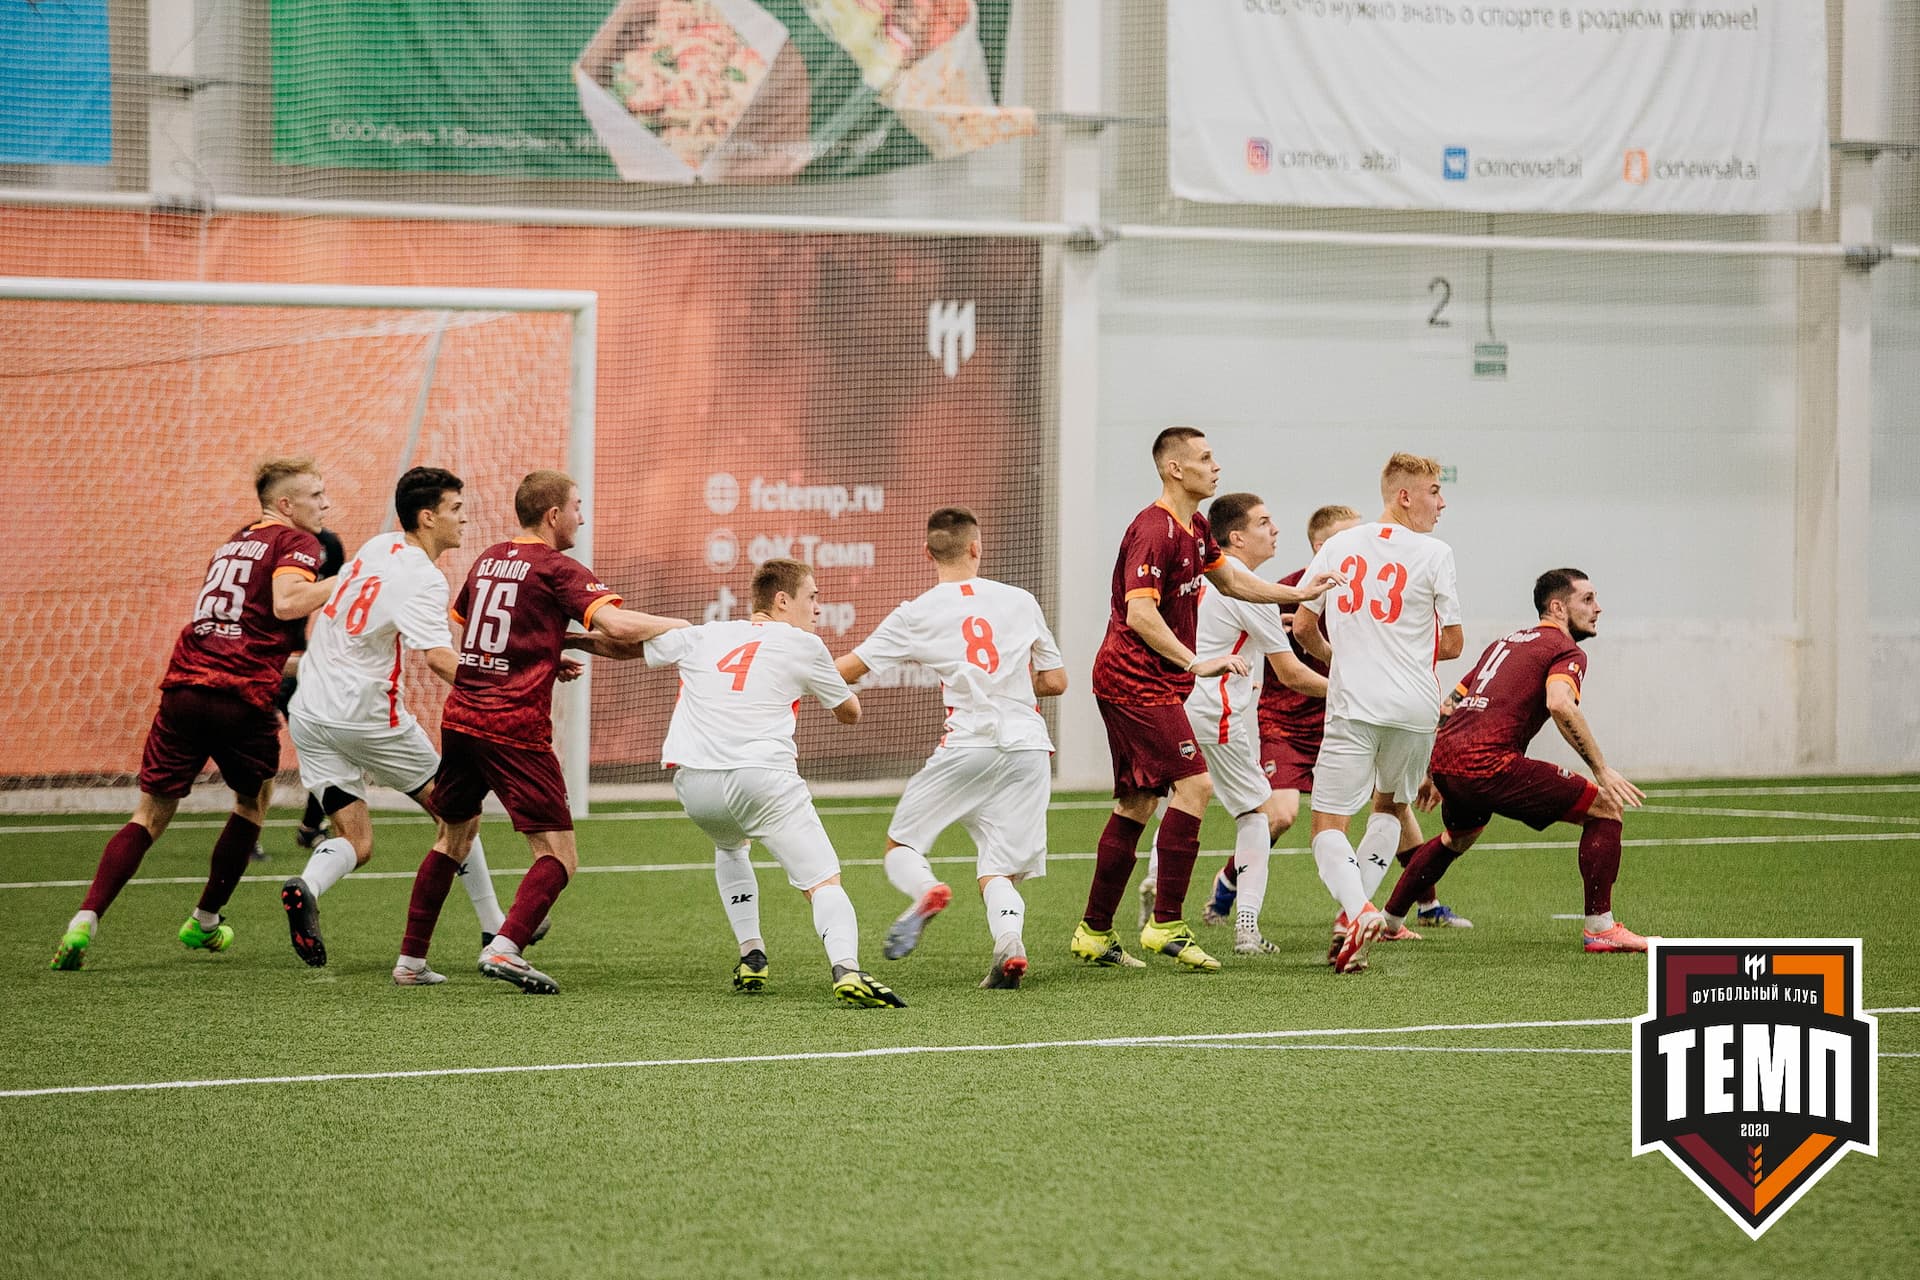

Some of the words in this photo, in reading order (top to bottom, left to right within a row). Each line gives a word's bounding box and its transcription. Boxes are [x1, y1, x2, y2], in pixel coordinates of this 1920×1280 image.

[1401, 4, 1457, 25] знать
[1480, 8, 1554, 31] спорте
[1578, 9, 1664, 33] родном
[1428, 277, 1450, 328] 2
[750, 476, 885, 519] fctemp.ru
[477, 557, 531, 581] БЕЛИКОВ
[748, 534, 793, 565] ФК
[800, 535, 876, 568] Темп
[193, 558, 253, 622] 25
[323, 558, 382, 636] 18
[1337, 553, 1408, 624] 33
[464, 578, 519, 654] 15
[716, 641, 762, 693] 4
[961, 615, 1000, 675] 8
[1475, 641, 1511, 695] 4
